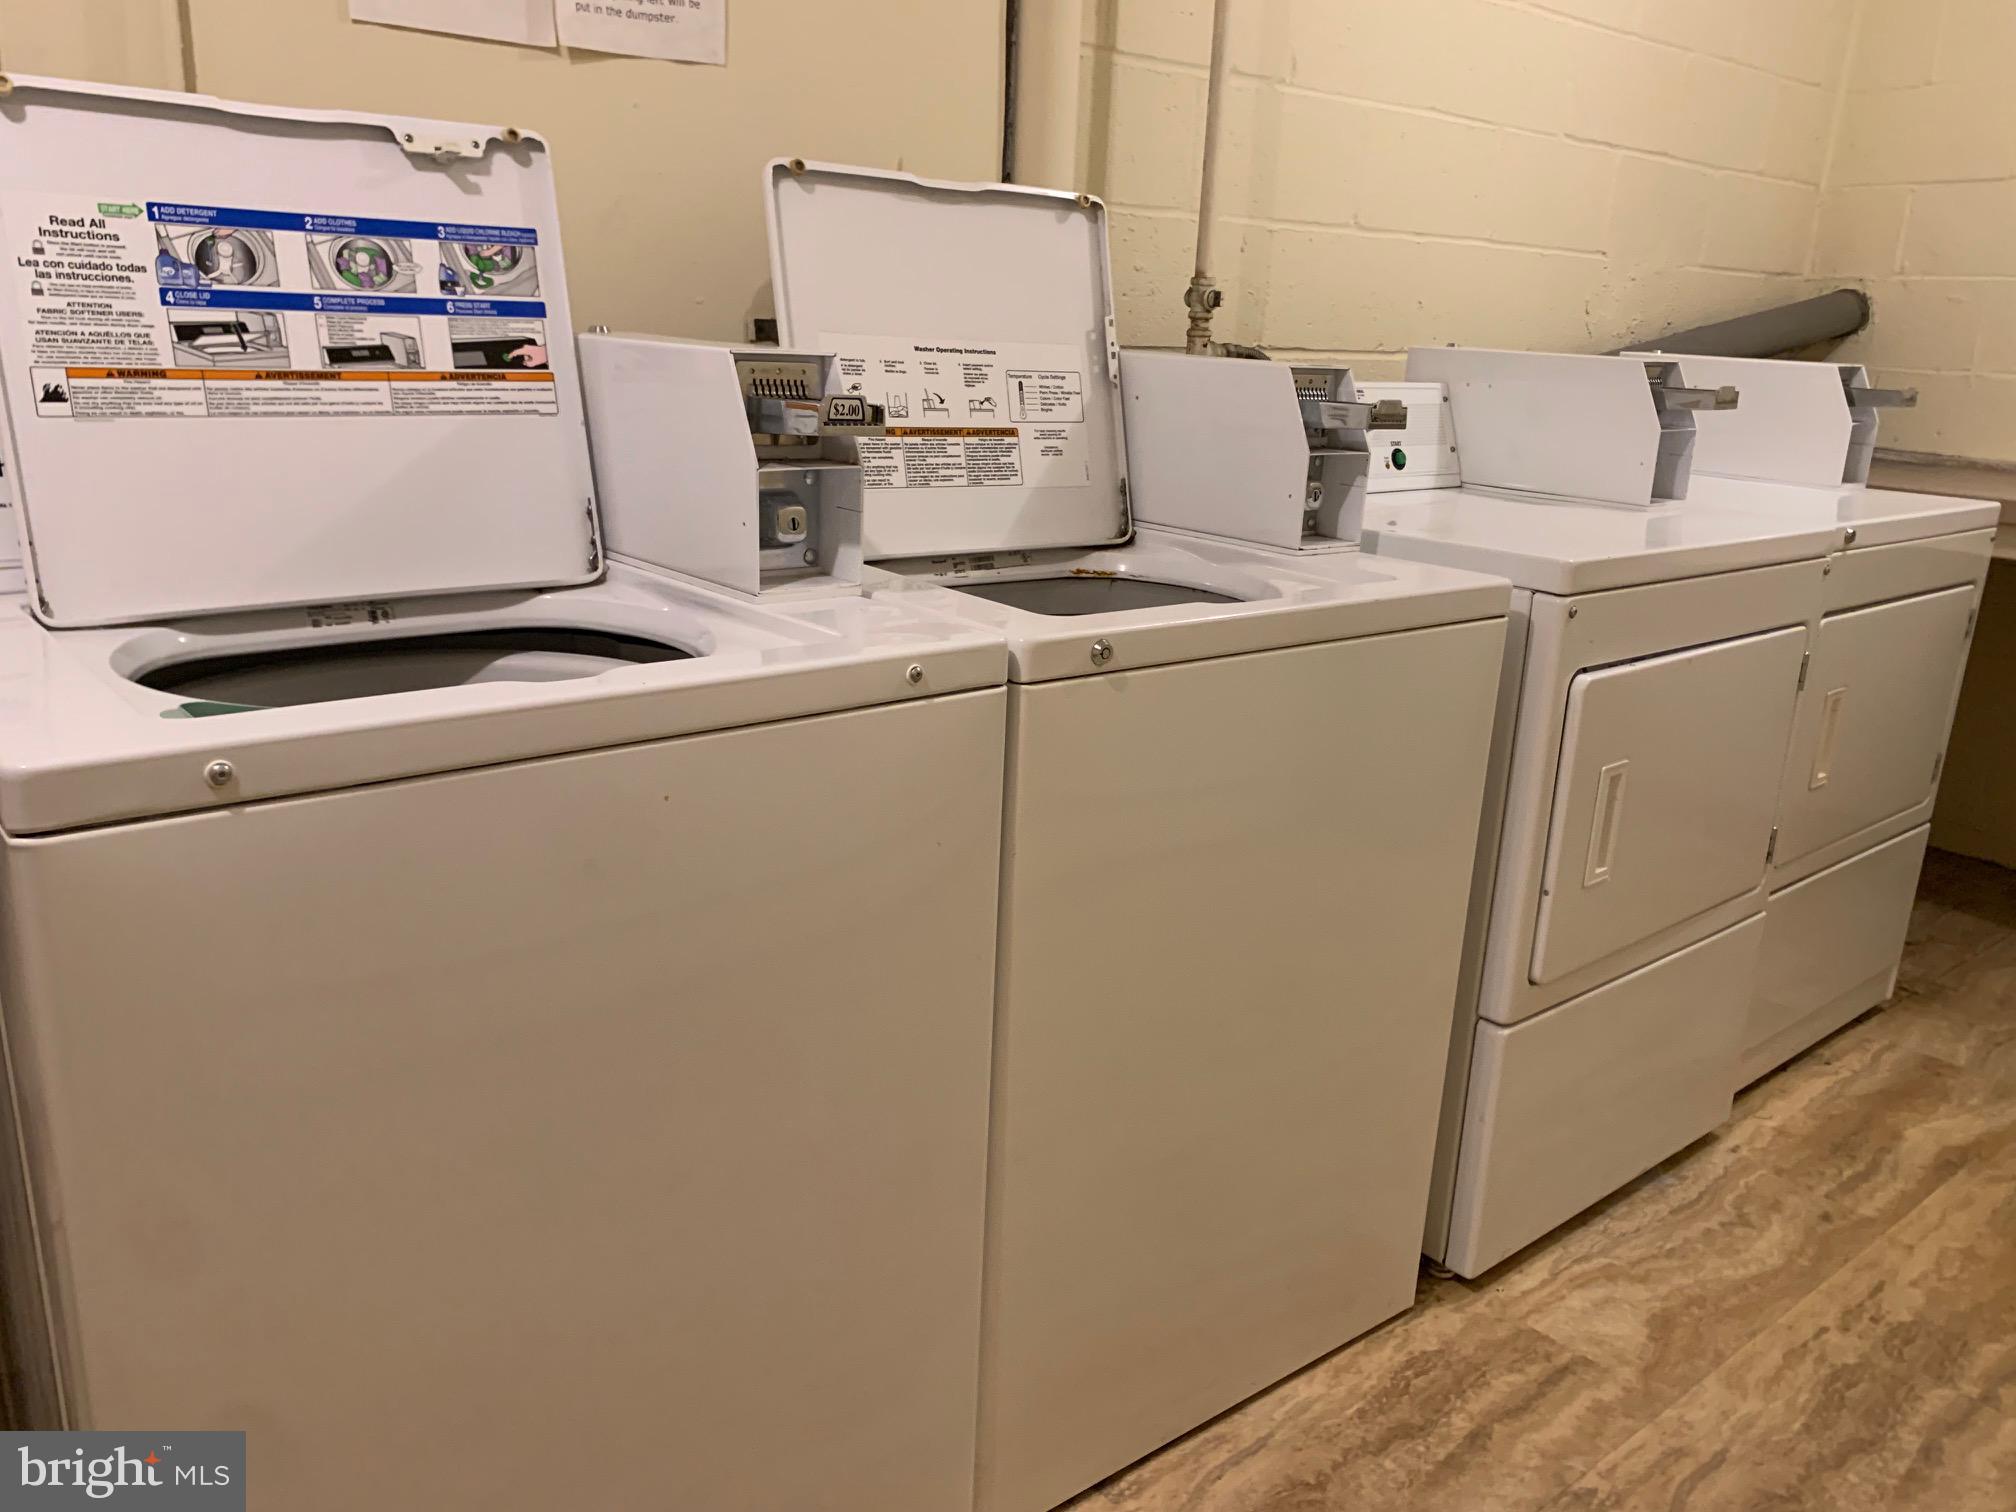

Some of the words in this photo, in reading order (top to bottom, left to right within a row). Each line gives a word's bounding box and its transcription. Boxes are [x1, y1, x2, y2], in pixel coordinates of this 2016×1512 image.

[689, 0, 701, 9] be
[575, 2, 591, 13] put
[594, 5, 603, 14] in
[606, 6, 622, 18] the
[626, 9, 679, 24] dumpster.
[152, 206, 159, 220] 1
[160, 206, 175, 214] ADD
[176, 207, 217, 217] DETERGENT
[49, 215, 85, 228] Read
[89, 218, 106, 229] All
[304, 216, 313, 230] 2
[313, 217, 327, 225] ADD
[328, 218, 357, 227] CLOTHES
[38, 226, 121, 242] Instructions
[437, 226, 445, 239] 3
[17, 257, 39, 268] Lea
[43, 260, 65, 269] con
[68, 260, 113, 272] cuidado
[116, 263, 147, 274] todas
[34, 269, 52, 279] las
[55, 270, 134, 284] instrucciones.
[166, 291, 175, 304] 4
[175, 291, 198, 299] CLOSE
[199, 292, 211, 300] LID
[314, 296, 322, 309] 5
[322, 296, 355, 304] COMPLETE
[66, 301, 113, 309] ATTENTION
[447, 301, 455, 313] 6
[62, 337, 112, 345] SUAVIZANTE
[914, 345, 935, 353] Washer
[936, 346, 963, 355] Operating
[117, 369, 167, 378] WARNING
[265, 372, 342, 381] AVERTISSEMENT
[449, 373, 507, 381] ADVERTENCIA
[833, 402, 860, 417] $2.00
